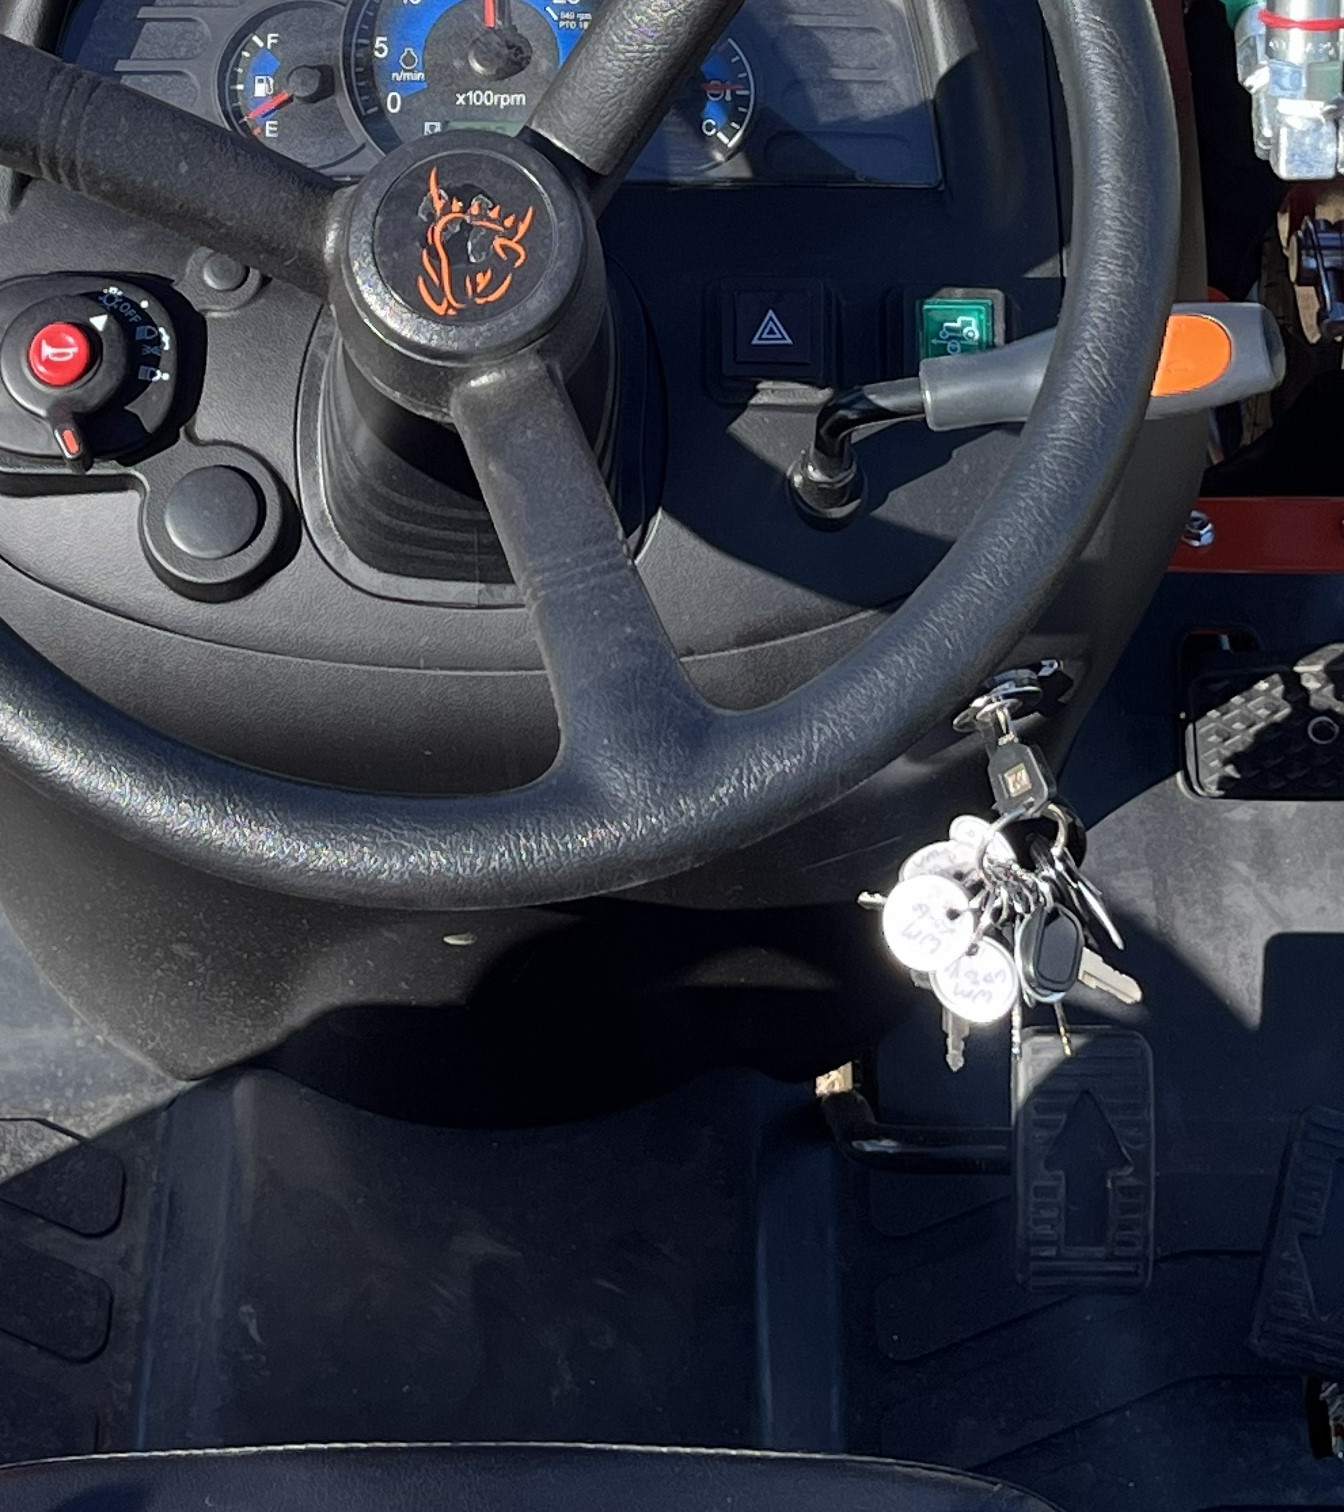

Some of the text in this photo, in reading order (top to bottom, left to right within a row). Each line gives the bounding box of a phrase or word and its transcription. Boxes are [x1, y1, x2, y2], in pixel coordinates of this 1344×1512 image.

[267, 34, 279, 49] F
[374, 37, 388, 58] 5
[392, 70, 425, 82] n/min
[387, 92, 402, 113] 0
[455, 91, 526, 108] x100rpm
[265, 121, 278, 137] E
[702, 119, 717, 136] C
[120, 302, 142, 323] OFF
